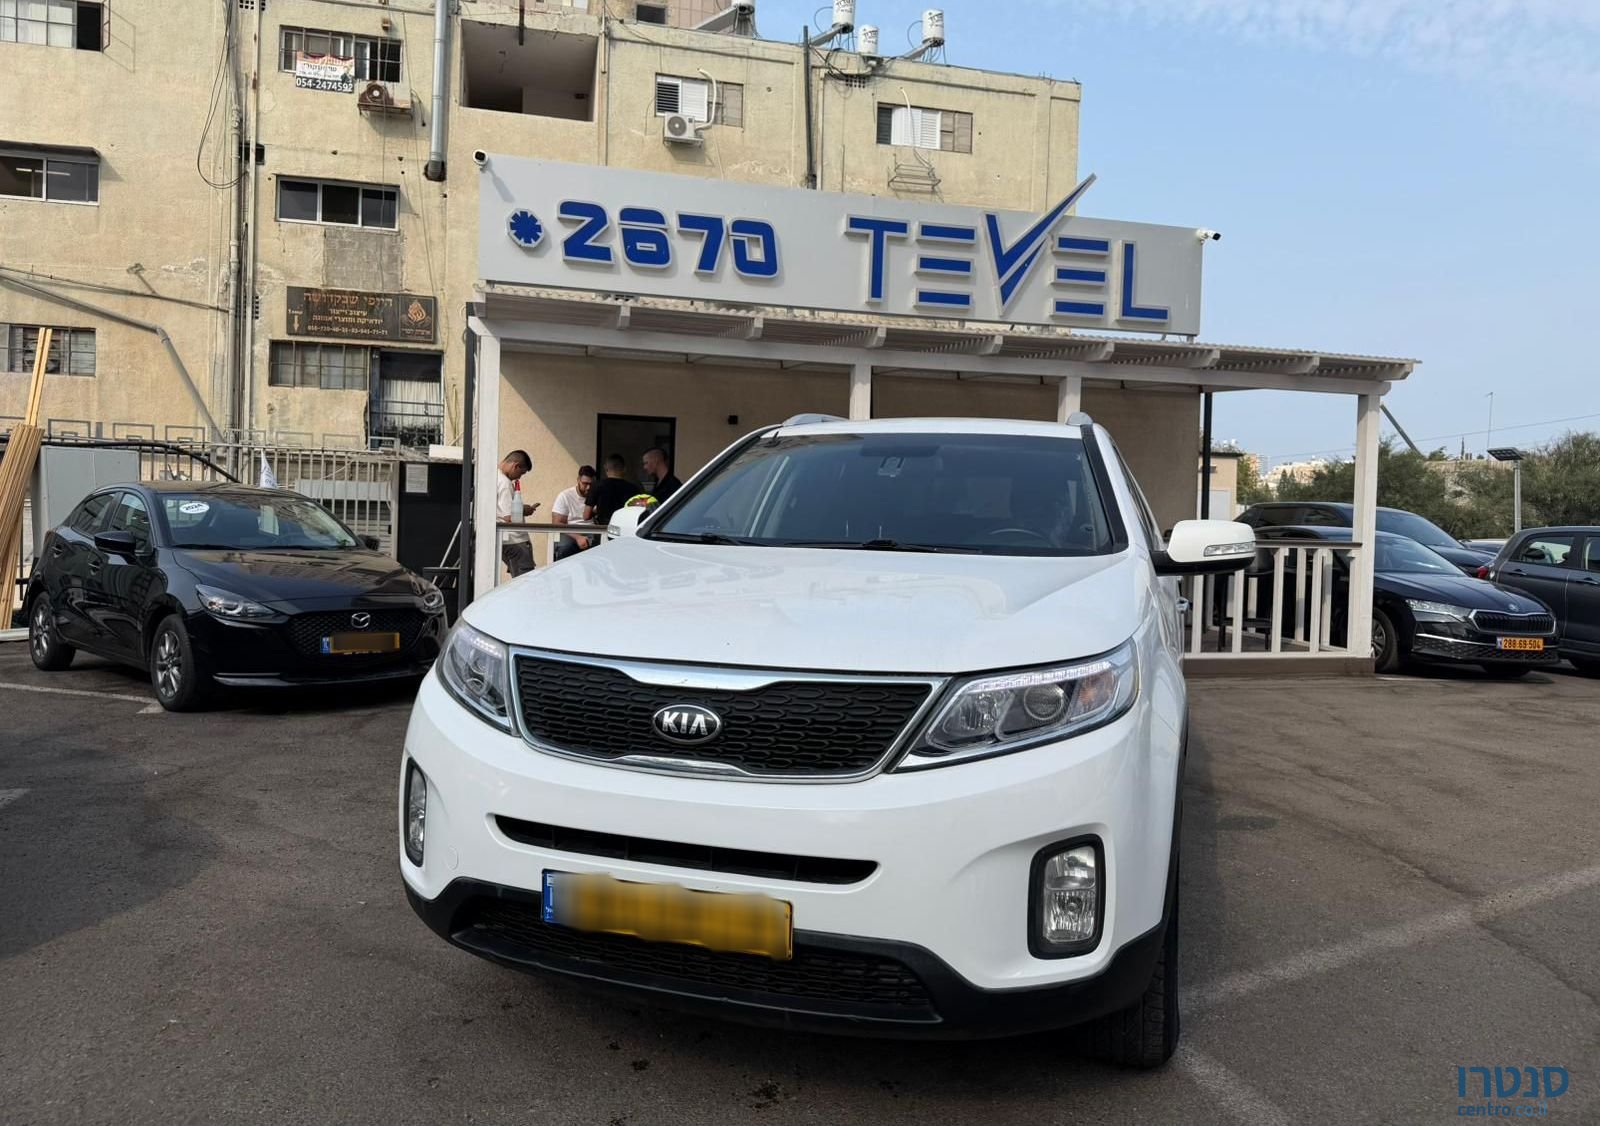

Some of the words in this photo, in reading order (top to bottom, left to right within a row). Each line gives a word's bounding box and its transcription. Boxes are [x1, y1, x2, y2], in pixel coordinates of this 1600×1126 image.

[296, 78, 353, 92] 054-2474592
[845, 172, 1169, 323] TEVEL
[662, 711, 708, 735] KIA
